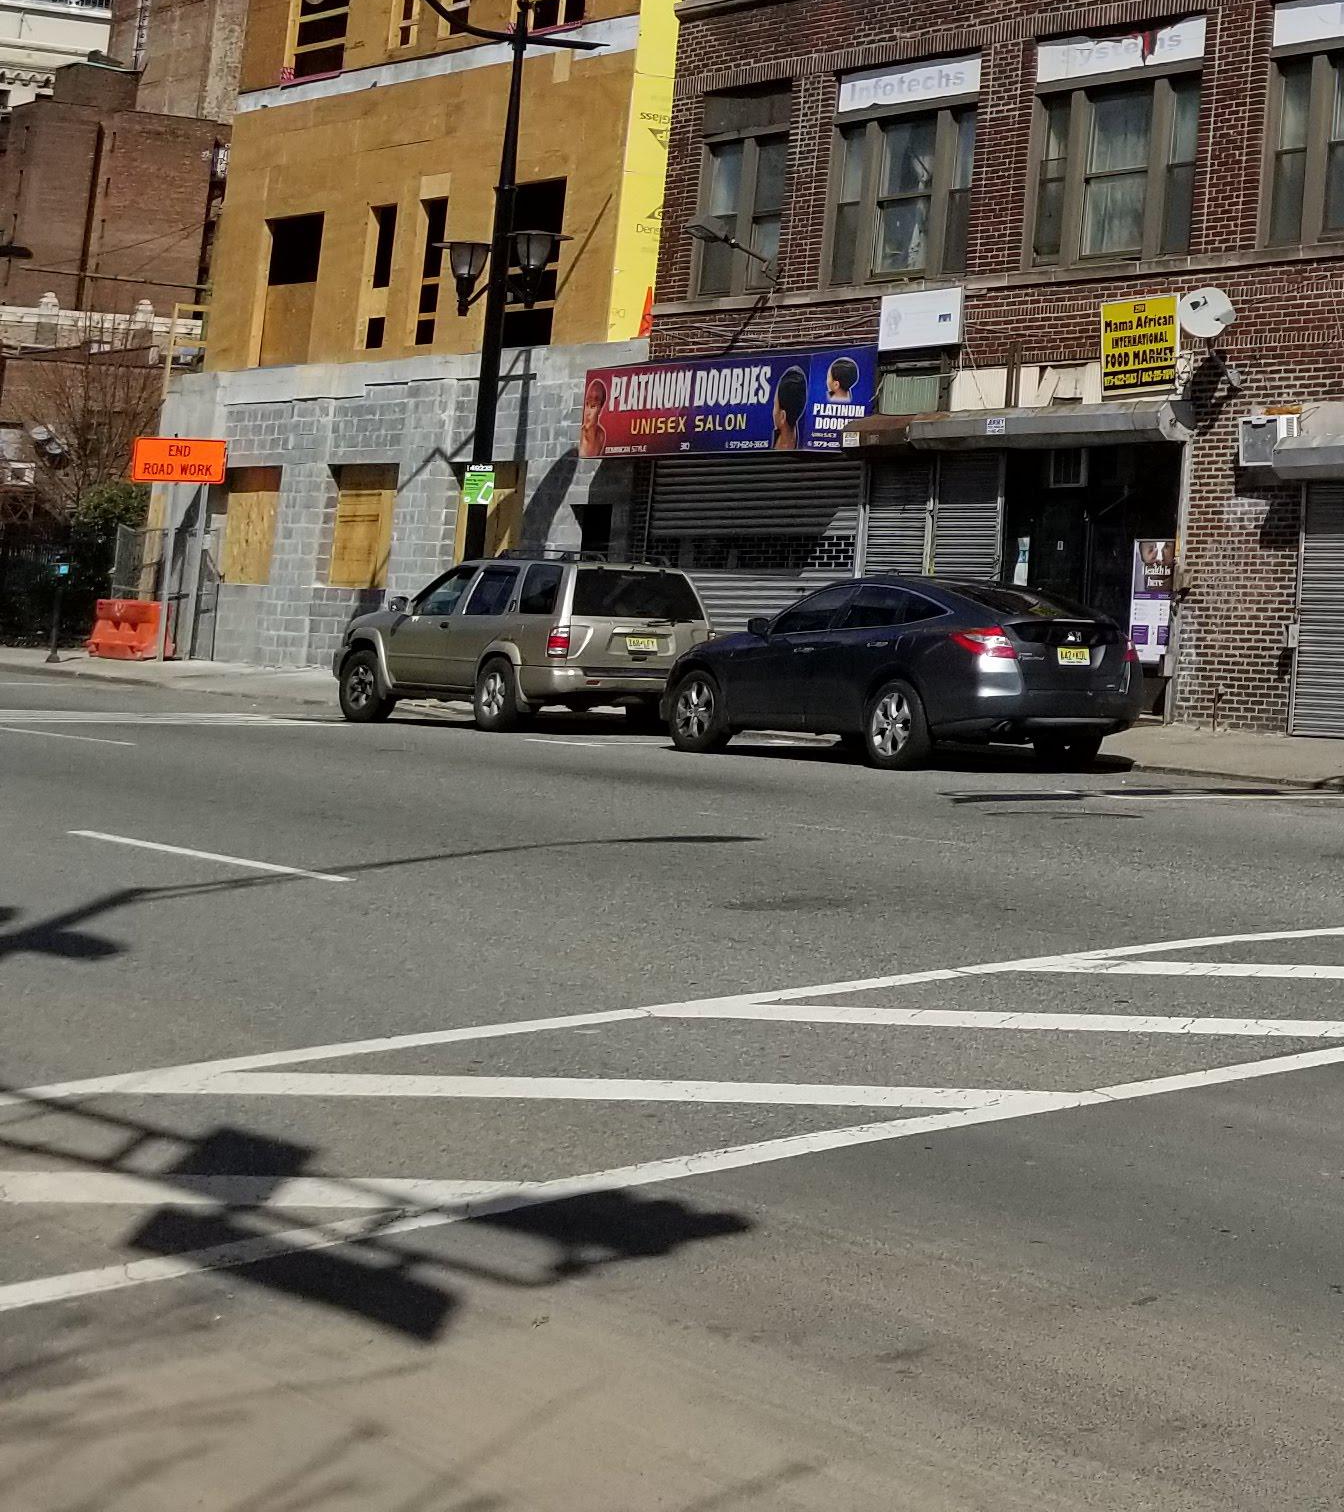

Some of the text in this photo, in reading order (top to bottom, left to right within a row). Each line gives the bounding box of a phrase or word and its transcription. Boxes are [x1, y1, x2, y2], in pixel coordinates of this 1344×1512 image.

[850, 69, 965, 102] Infotechs
[1105, 315, 1174, 333] Mama African
[1112, 331, 1168, 349] INTERNATIONAL
[1105, 346, 1174, 368] FOOD MARKET
[608, 366, 772, 412] PLATINUM DOOBIES
[813, 403, 865, 417] PLATINUM
[630, 414, 747, 435] UNISEX SALON
[168, 445, 191, 457] END
[143, 463, 212, 476] ROAD WORK
